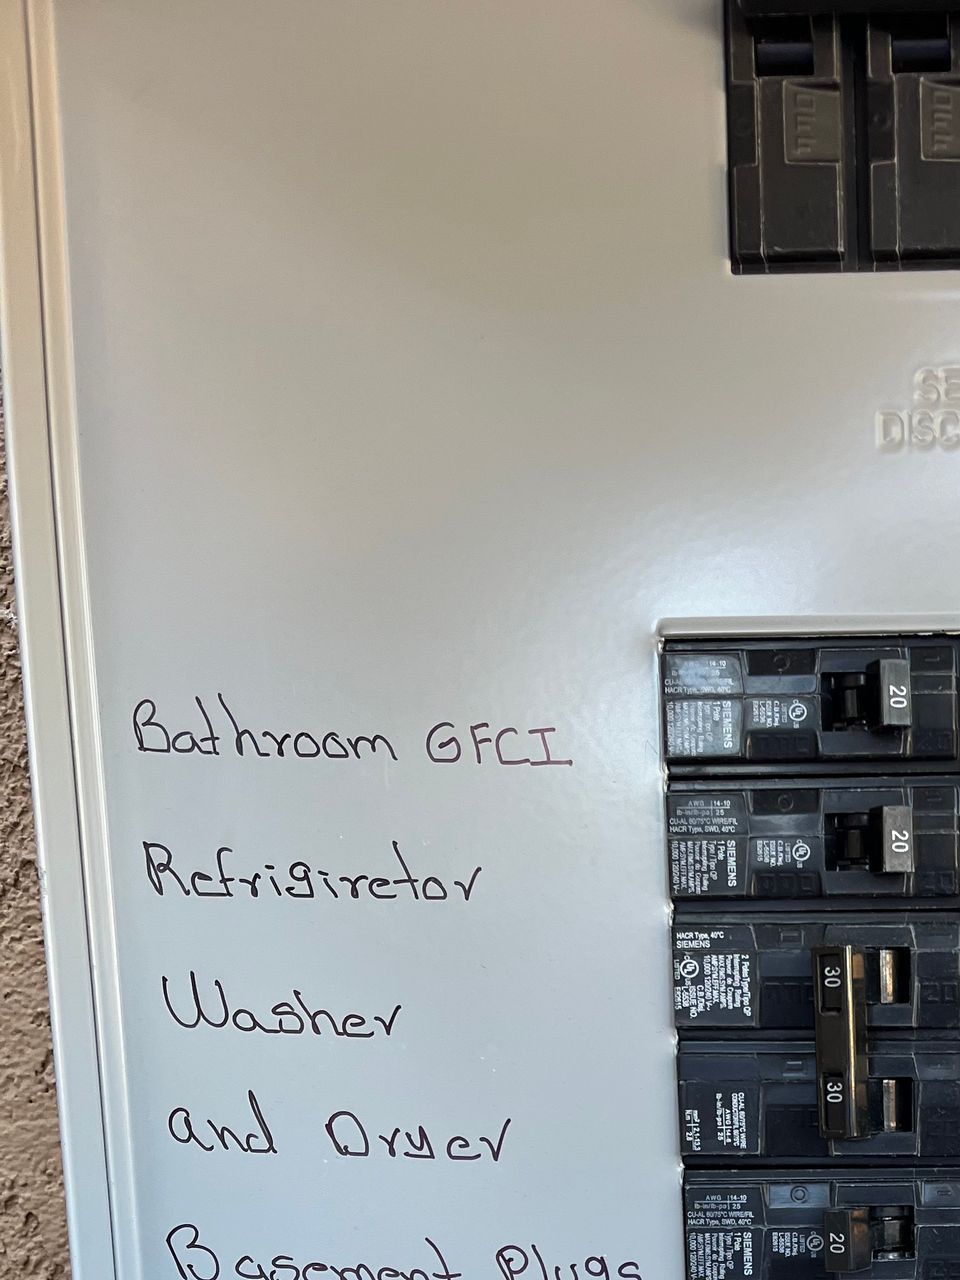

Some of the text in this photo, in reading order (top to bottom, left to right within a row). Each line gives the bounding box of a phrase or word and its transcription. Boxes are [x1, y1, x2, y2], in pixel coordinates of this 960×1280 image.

[889, 684, 907, 709] 20
[132, 693, 574, 766] Bathroom GFCI
[722, 699, 734, 749] SIEMENS
[890, 829, 909, 854] 20
[726, 839, 737, 887] SIEMENS
[676, 940, 711, 949] SIEMENS
[824, 965, 841, 989] 30
[161, 970, 402, 1038] Washer
[826, 1081, 843, 1104] 30
[324, 1110, 512, 1162] Dryer
[742, 1231, 753, 1277] SIEMENS
[829, 1232, 846, 1255] 20
